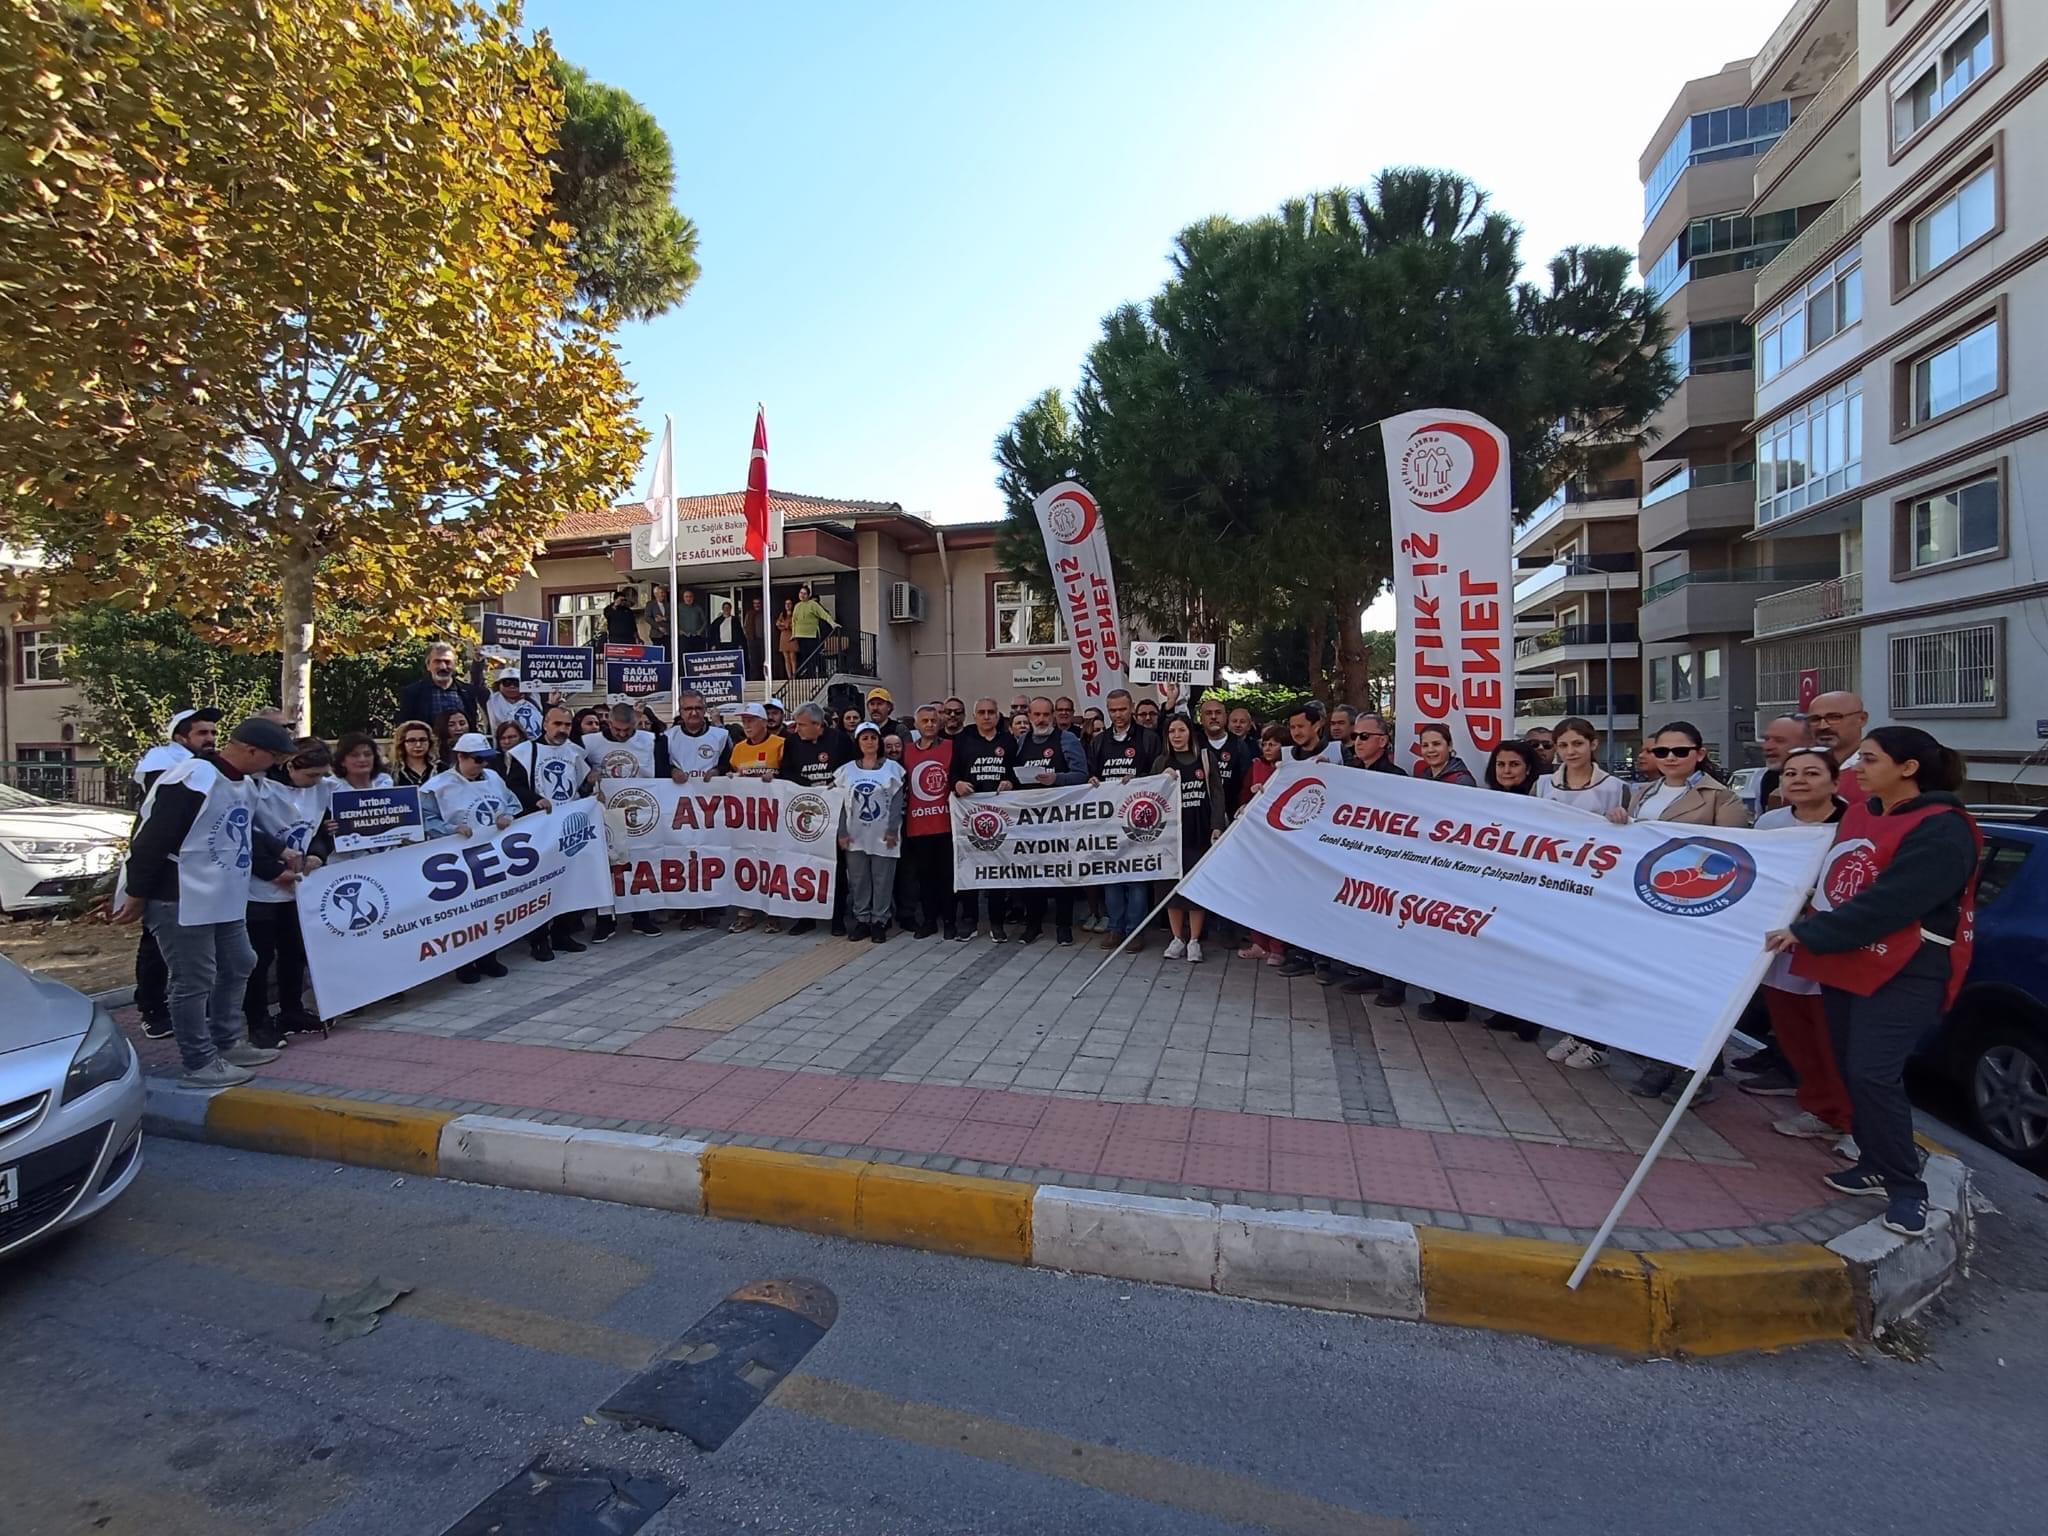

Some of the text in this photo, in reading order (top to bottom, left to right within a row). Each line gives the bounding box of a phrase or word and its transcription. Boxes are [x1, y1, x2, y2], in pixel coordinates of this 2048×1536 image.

[686, 525, 699, 534] T.C.
[702, 522, 723, 534] Sağlık
[710, 534, 734, 545] SÖKE
[689, 548, 721, 560] SAĞLIK
[496, 618, 540, 631] SERMAYE
[1158, 646, 1188, 656] AYDIN
[530, 670, 558, 678] PARA
[624, 666, 656, 676] SAĞLIK
[622, 674, 658, 682] BAKANI
[690, 680, 732, 688] SAĞLIKTA
[625, 683, 656, 692] İSTİFA!
[802, 763, 828, 772] AYDIN
[1104, 758, 1133, 766] AYDIN
[1182, 781, 1203, 790] YDIN
[359, 797, 392, 808] İKTİDAR
[672, 796, 780, 832] AYDIN
[1016, 801, 1114, 826] AYAHED
[559, 826, 598, 852] KESK
[1013, 834, 1118, 855] AYDIN AİLE
[1332, 804, 1622, 879] GENEL SAĞLIK-İŞ
[422, 832, 540, 902] SES
[975, 853, 1162, 880] HEKİMLERİ DERNEĞİ
[1319, 834, 1595, 896] Genel Sağlık ve Sosyal Hizmet Kolu Kamu Çalışanları Sendikası
[610, 850, 830, 904] TABİP ODASI
[383, 918, 418, 940] SAĞLIK
[418, 916, 432, 926] VE
[434, 904, 470, 922] SOSYAL
[470, 893, 500, 909] HİZMET
[500, 878, 538, 900] EMEKÇİLERİ
[1333, 876, 1498, 938] AYDIN ŞUBESİ
[419, 888, 552, 962] AYDIN ŞUBESİ
